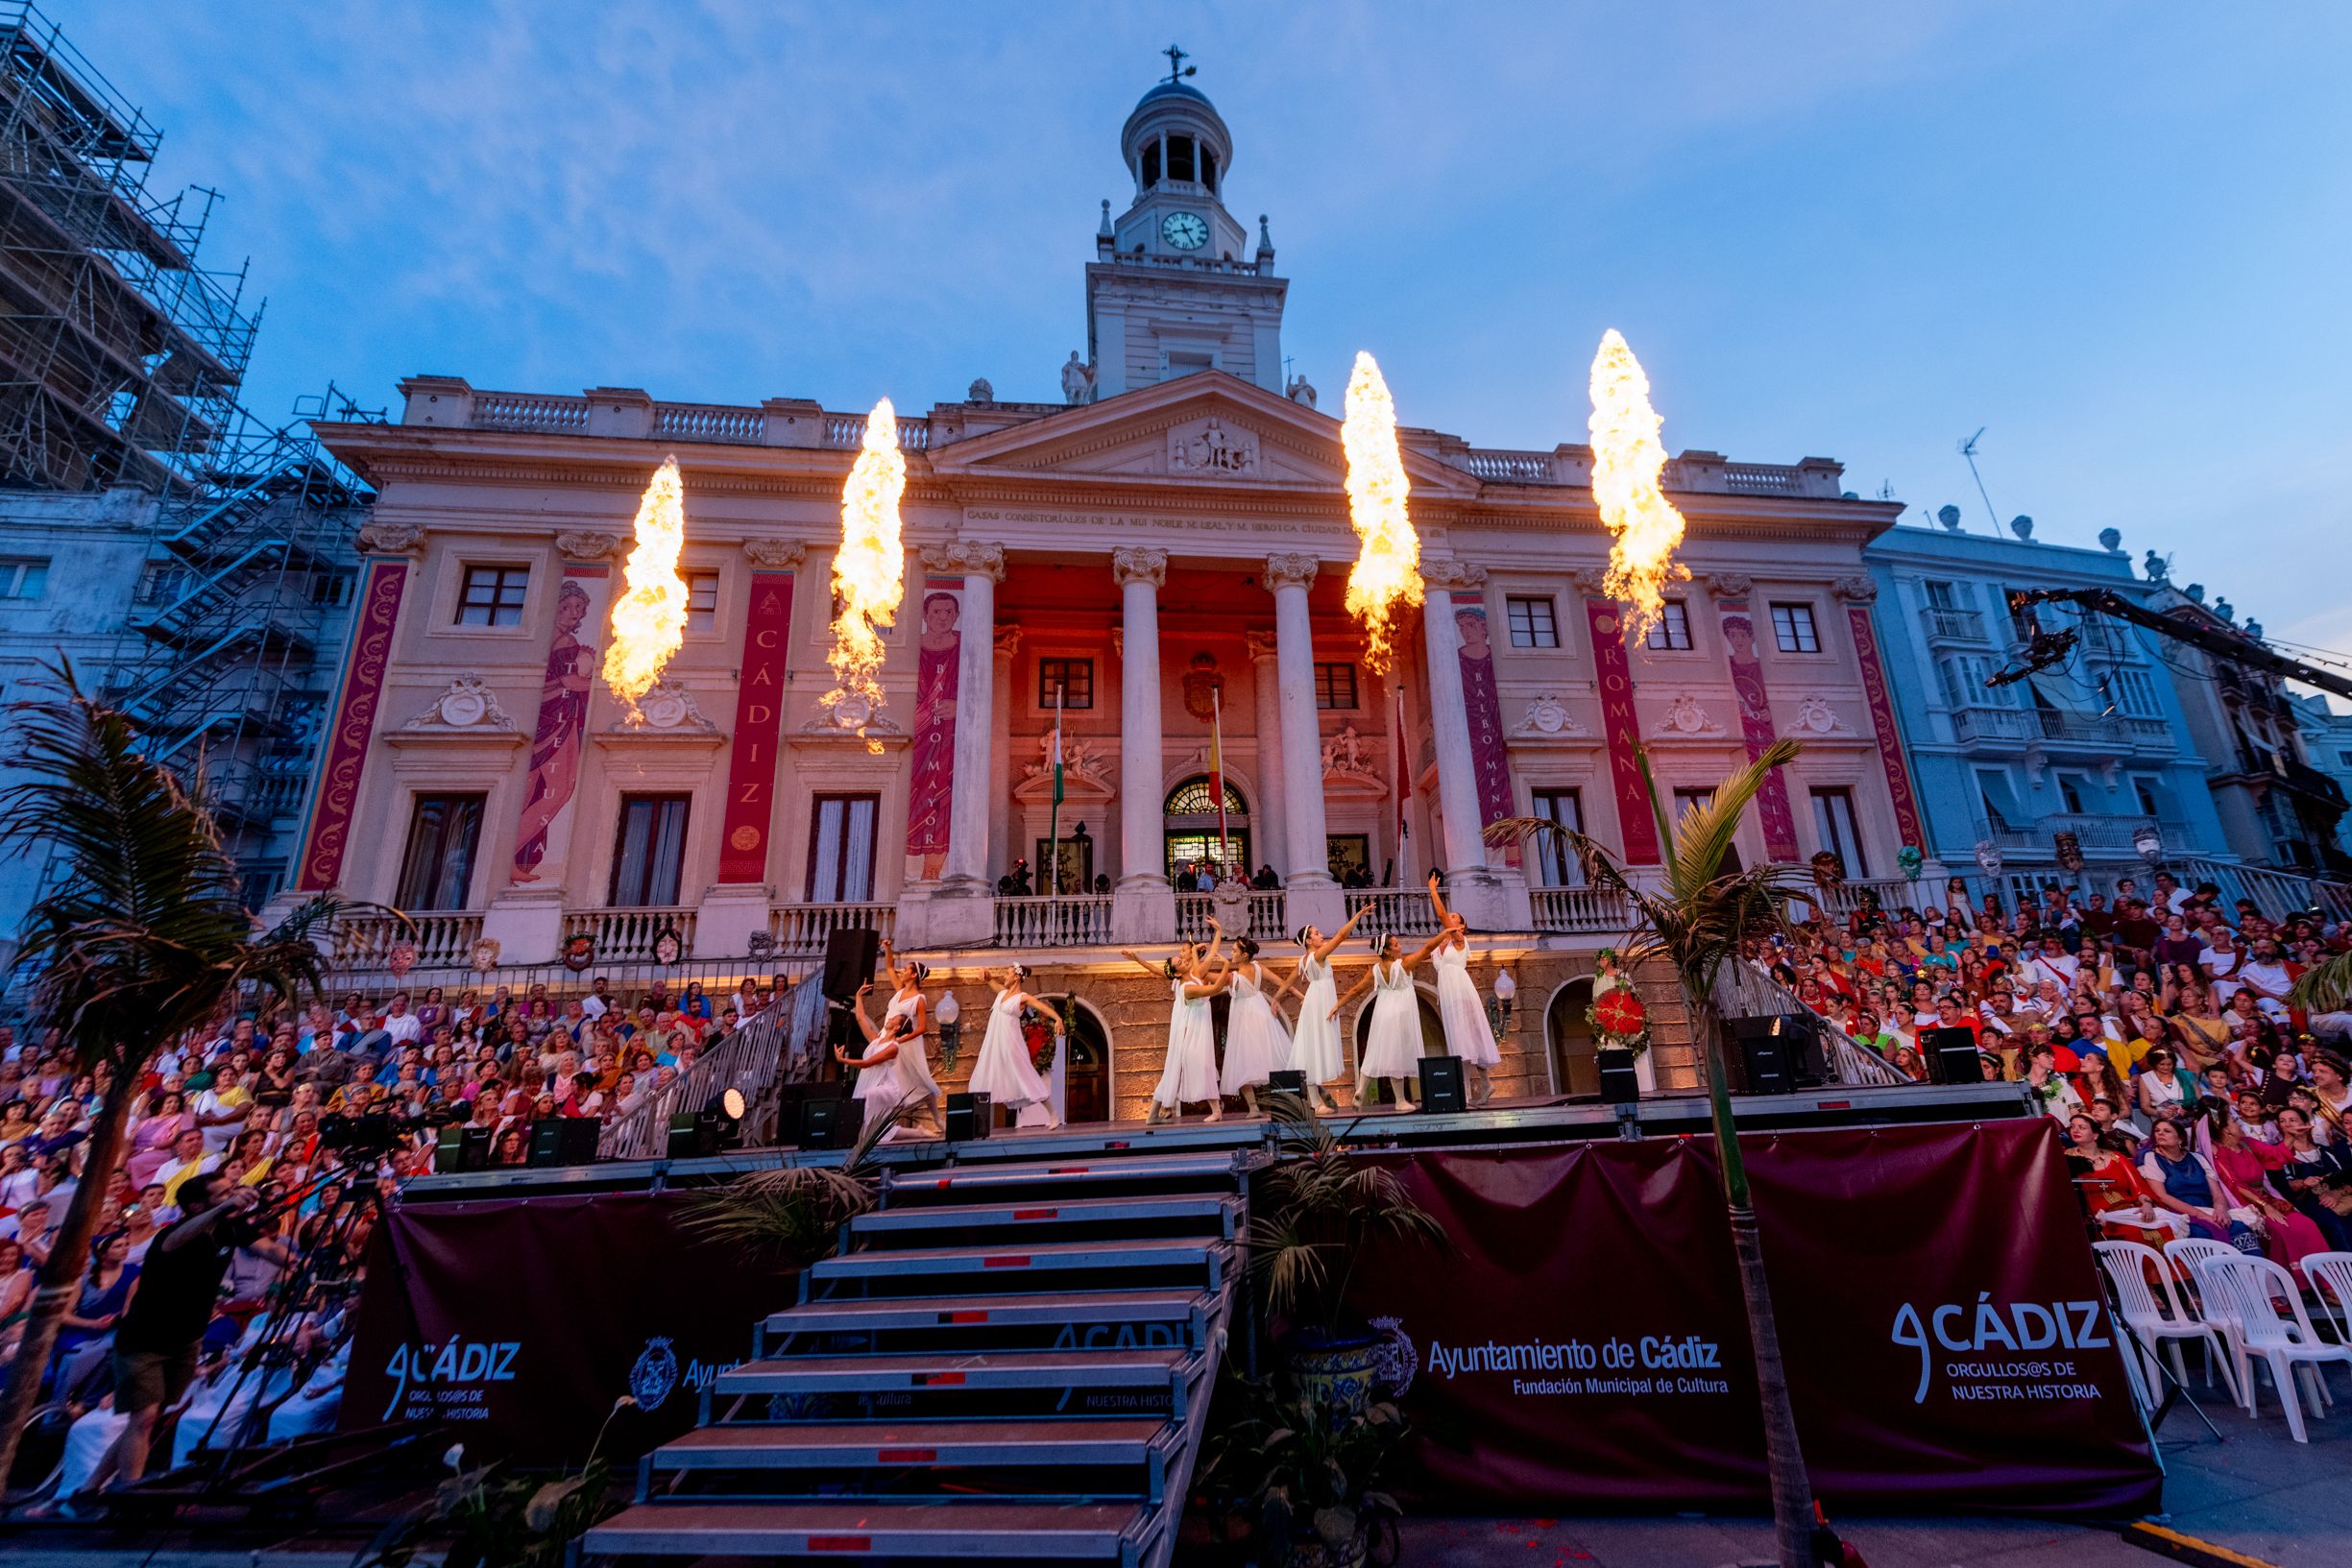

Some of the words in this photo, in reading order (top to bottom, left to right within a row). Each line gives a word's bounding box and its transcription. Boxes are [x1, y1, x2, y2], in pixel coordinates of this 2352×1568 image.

[1110, 517, 1124, 525] LA
[740, 629, 778, 804] CÁDIZ
[930, 663, 945, 743] BALBO
[1604, 648, 1640, 801] ROMANA
[532, 661, 577, 854] TELETUSA
[1474, 671, 1492, 745] BALBO
[1486, 760, 1504, 820] MENO
[925, 760, 940, 844] MAYOR
[1931, 1291, 2111, 1352] CÁDIZ
[1427, 1339, 1597, 1376] Ayuntamiento
[1603, 1336, 1636, 1369] de
[1640, 1335, 1722, 1369] Cádiz
[1947, 1363, 2051, 1378] ORGULLOS@S
[2054, 1362, 2077, 1376] DE
[468, 1390, 485, 1402] DE
[1086, 1394, 1138, 1407] NUESTRA
[1140, 1394, 1175, 1407] HISTO
[1514, 1378, 1583, 1395] Fundación
[1586, 1377, 1652, 1397] Municipal
[1657, 1377, 1674, 1393] de
[1677, 1377, 1729, 1393] Cultura
[1952, 1386, 2025, 1400] NUESTRA
[2026, 1385, 2102, 1399] HISTORIA
[447, 1407, 489, 1420] HISTORIA
